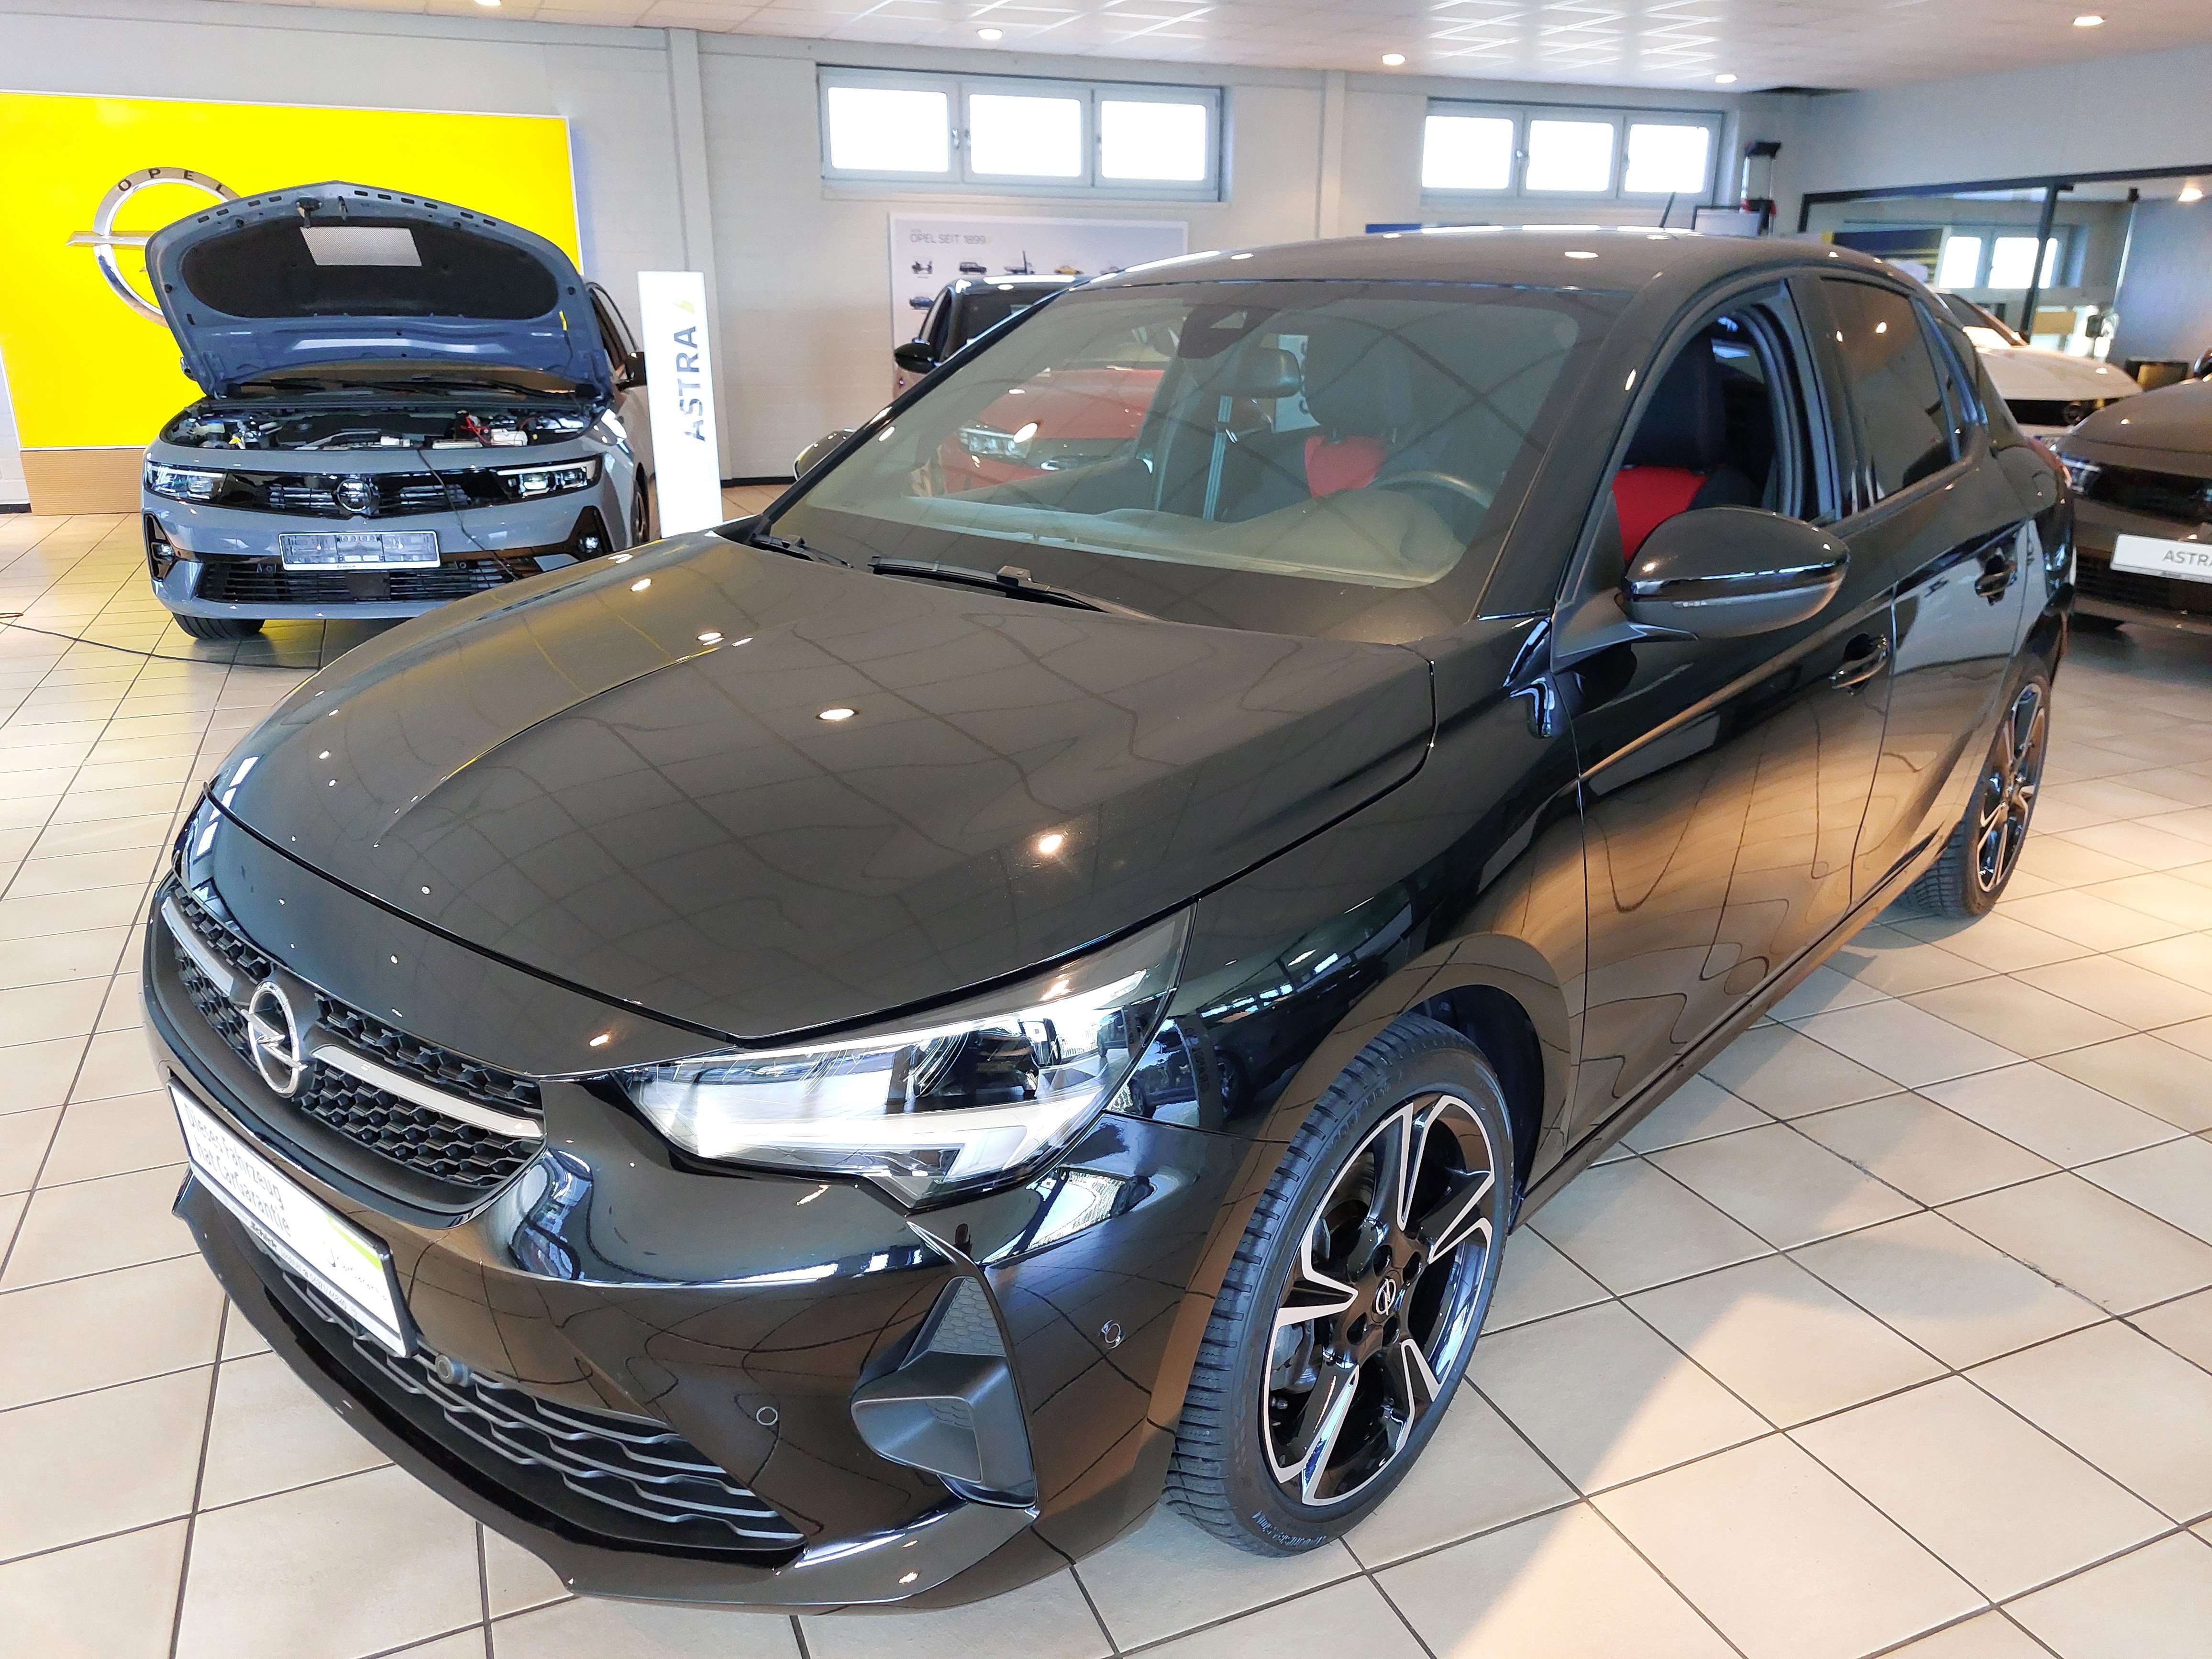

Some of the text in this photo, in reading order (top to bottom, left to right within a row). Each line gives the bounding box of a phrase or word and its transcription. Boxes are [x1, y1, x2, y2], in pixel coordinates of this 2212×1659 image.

[118, 167, 226, 194] OPEL
[911, 233, 936, 243] OPEL
[673, 326, 706, 442] ASTRA
[2162, 550, 2212, 567] ASTR
[184, 1103, 223, 1153] Dieses
[221, 1136, 285, 1211] Fahrzeug
[194, 1135, 218, 1172] hat
[216, 1155, 291, 1238] CarGarantie
